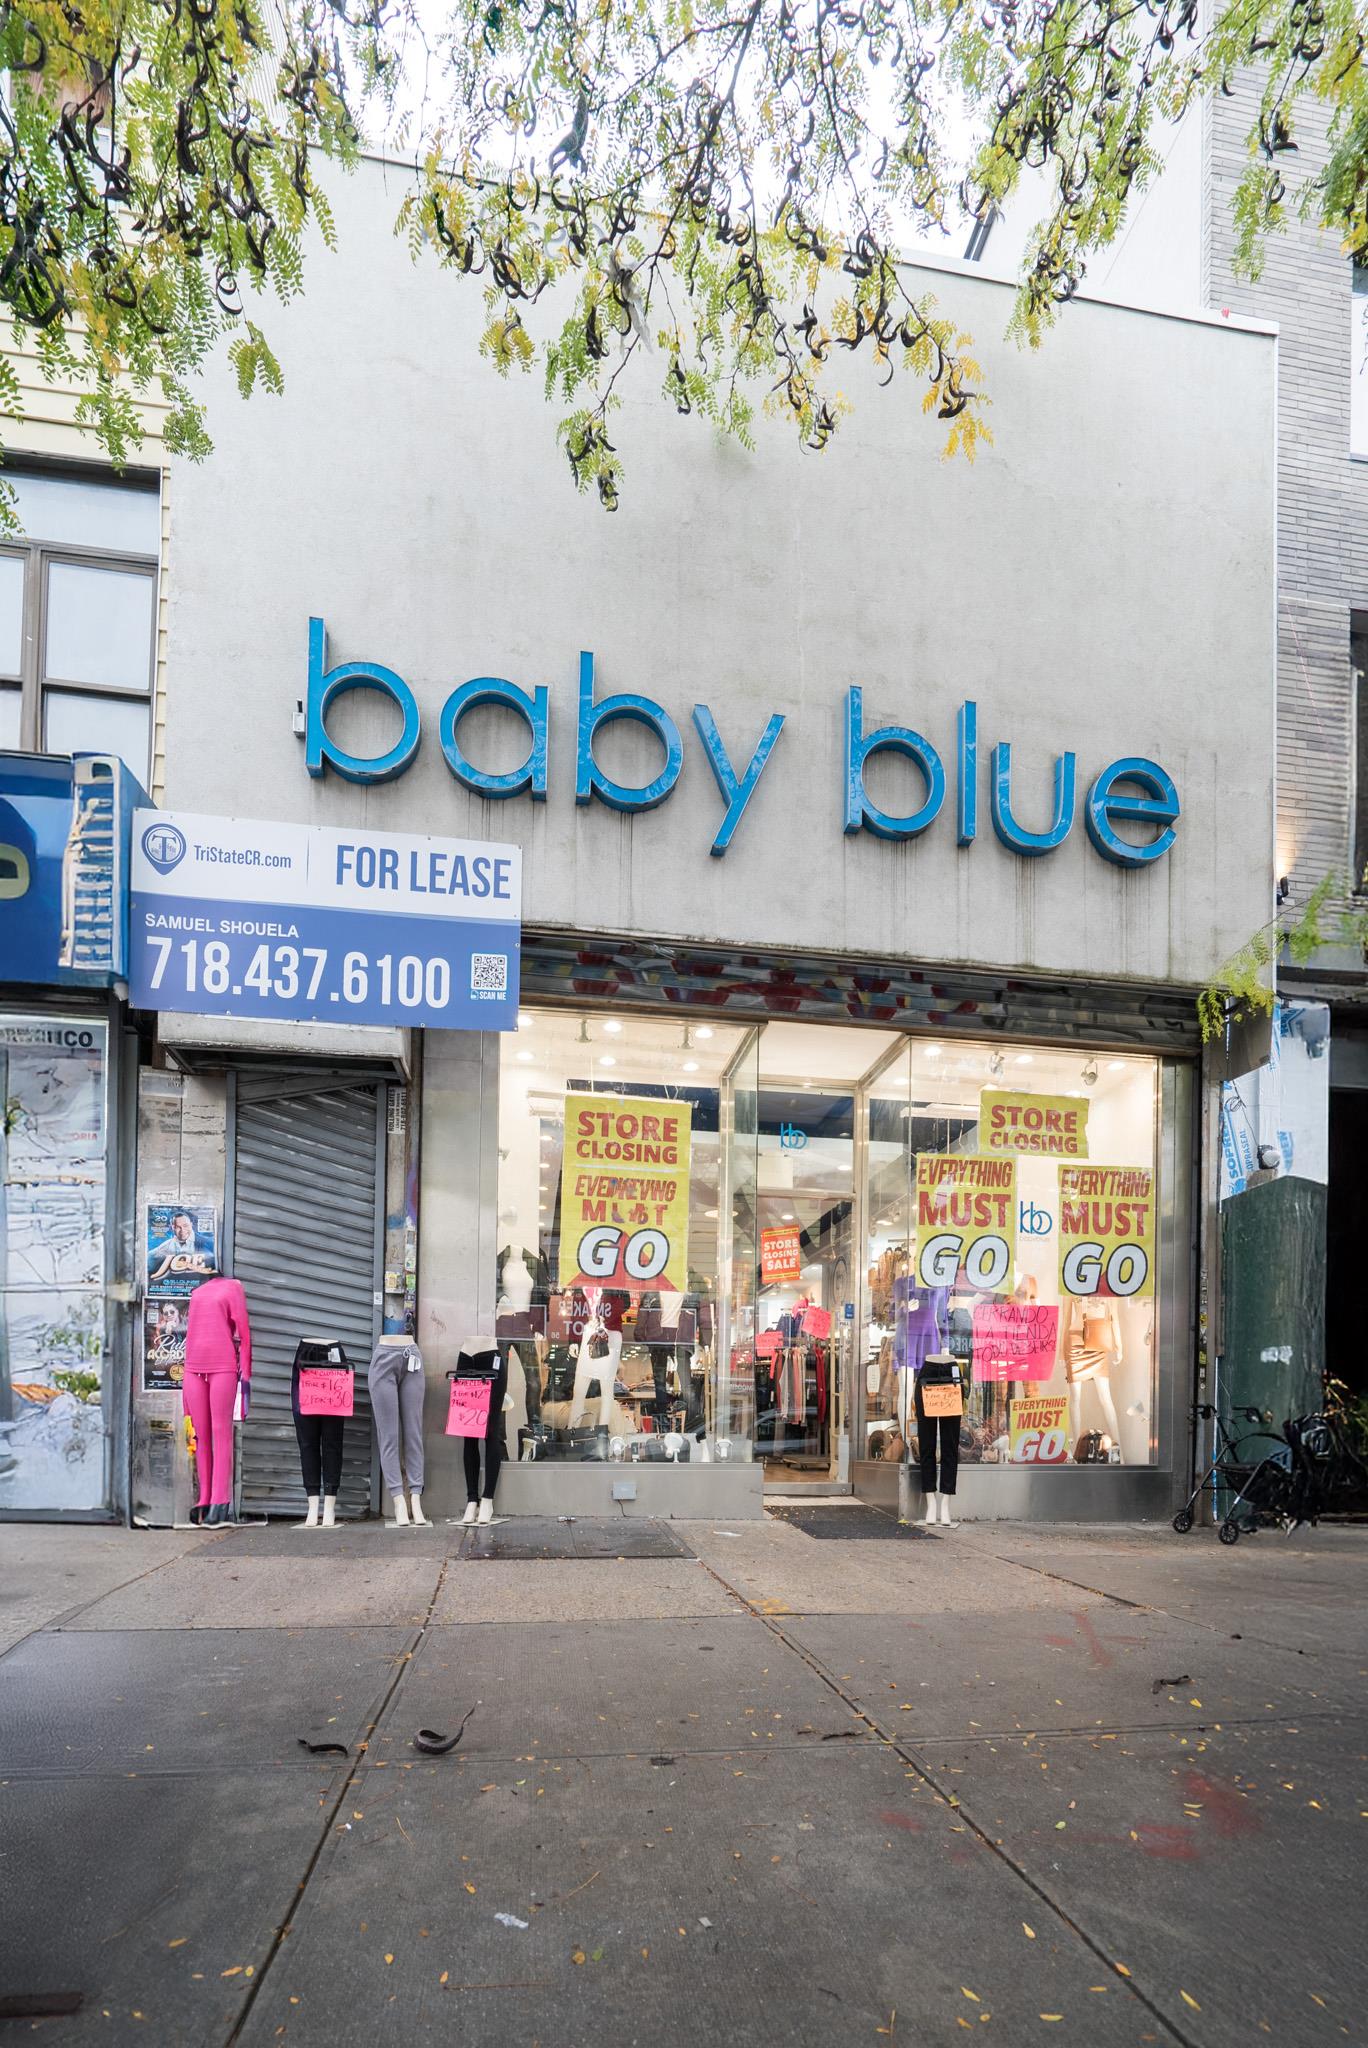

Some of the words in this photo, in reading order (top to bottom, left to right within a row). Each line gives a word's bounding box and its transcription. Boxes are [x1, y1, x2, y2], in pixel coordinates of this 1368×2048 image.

[306, 616, 786, 857] baby
[844, 685, 1180, 868] blue
[193, 844, 292, 869] TriStateCR.com
[336, 844, 399, 891] FOR
[410, 850, 511, 900] LEASE
[145, 912, 215, 935] SAMUEL
[219, 919, 299, 939] SHOUELA
[146, 935, 451, 1009] 718.437.6100
[479, 990, 497, 1000] SCAN
[577, 1110, 678, 1142] STORE
[990, 1104, 1077, 1133] STORE
[576, 1140, 678, 1164] CLOSING
[990, 1132, 1077, 1153] CLOSING
[918, 1157, 1013, 1188] EVERYTHING
[1061, 1169, 1151, 1198] EVERYTHING
[919, 1191, 1011, 1228] MUST
[1062, 1201, 1149, 1236] MUST
[577, 1225, 670, 1281] GO
[763, 1239, 798, 1251] STORE
[763, 1249, 798, 1260] CLOSING
[767, 1258, 796, 1270] SALE
[919, 1233, 1010, 1290] GO
[1062, 1242, 1149, 1297] GO
[1002, 1322, 1057, 1341] TIENDA
[1012, 1397, 1067, 1411] EVERYTHING
[1016, 1410, 1063, 1429] MUST
[1013, 1430, 1066, 1462] GO
